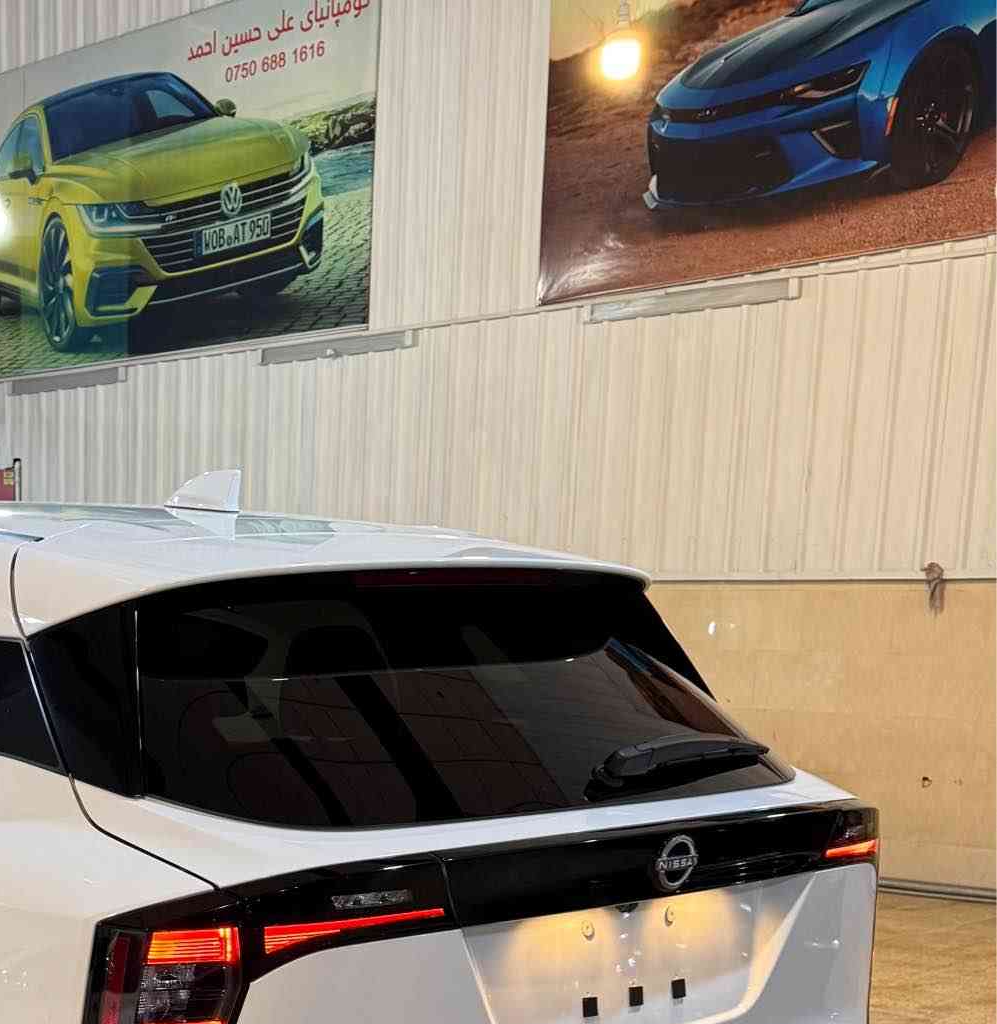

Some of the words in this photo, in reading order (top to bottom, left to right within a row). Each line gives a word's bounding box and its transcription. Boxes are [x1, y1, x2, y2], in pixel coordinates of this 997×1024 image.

[225, 60, 257, 83] 0750
[261, 51, 286, 73] 688
[292, 41, 325, 64] 1616
[249, 216, 270, 239] 950
